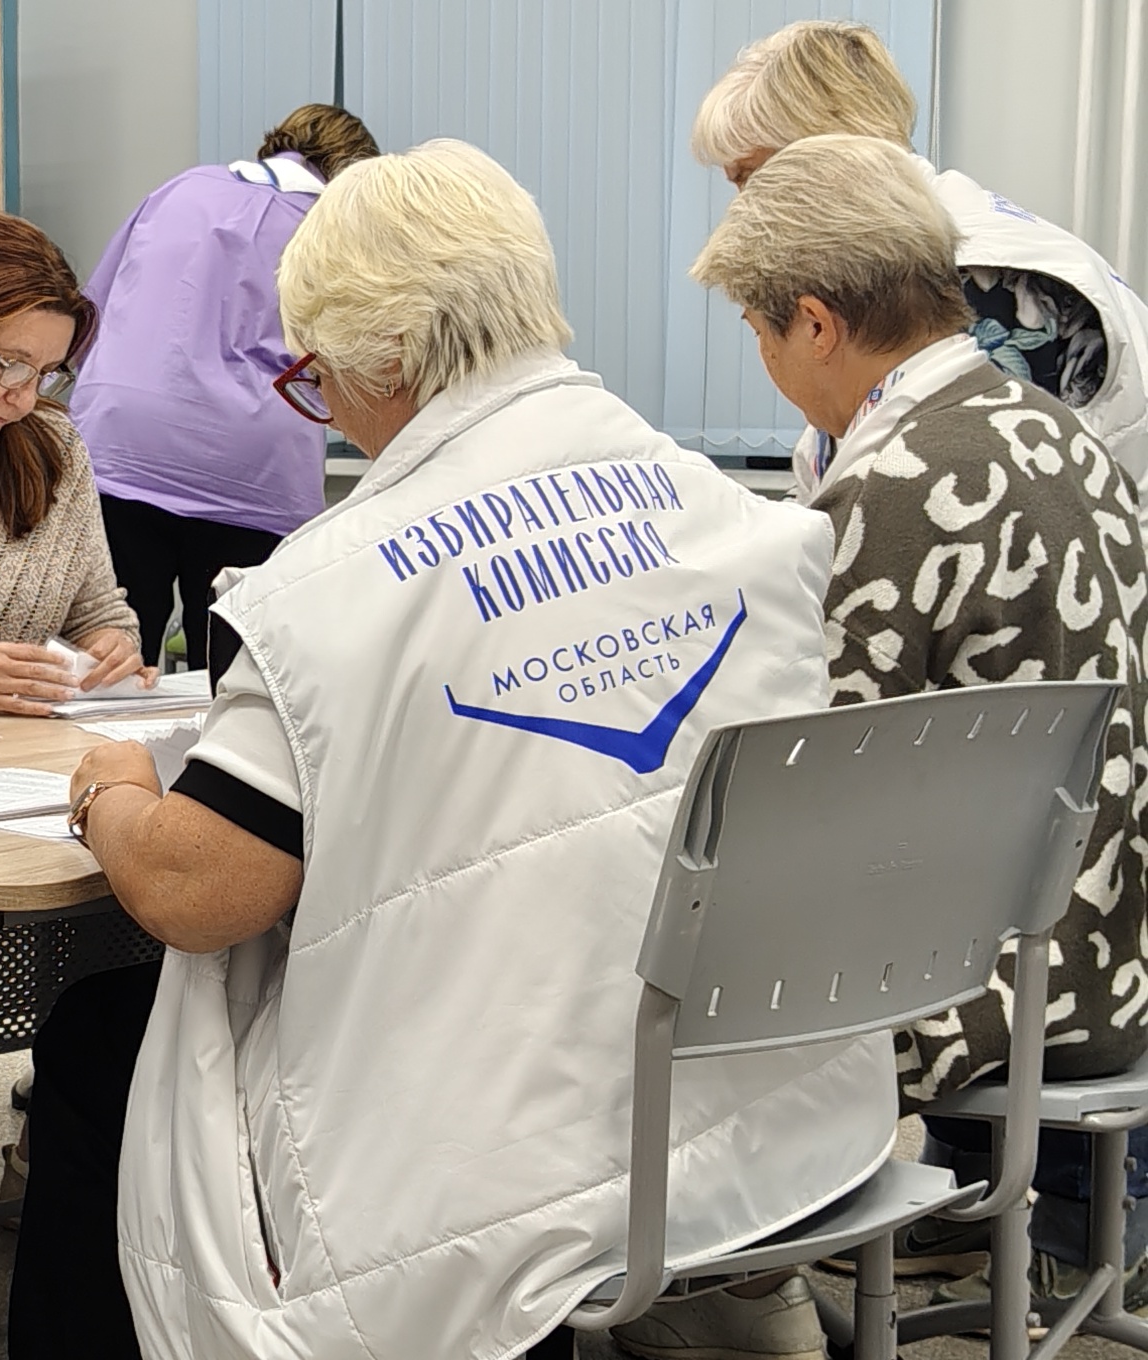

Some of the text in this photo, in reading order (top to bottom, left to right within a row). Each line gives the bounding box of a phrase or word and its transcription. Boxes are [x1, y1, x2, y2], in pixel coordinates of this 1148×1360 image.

[378, 463, 684, 581] ИЗБИРАТЕЛЬНАЯ
[461, 521, 680, 622] КОМИССИЯ
[491, 604, 717, 696] МОСКОВСКАЯ
[558, 653, 680, 703] ОБЛАСТЬ
